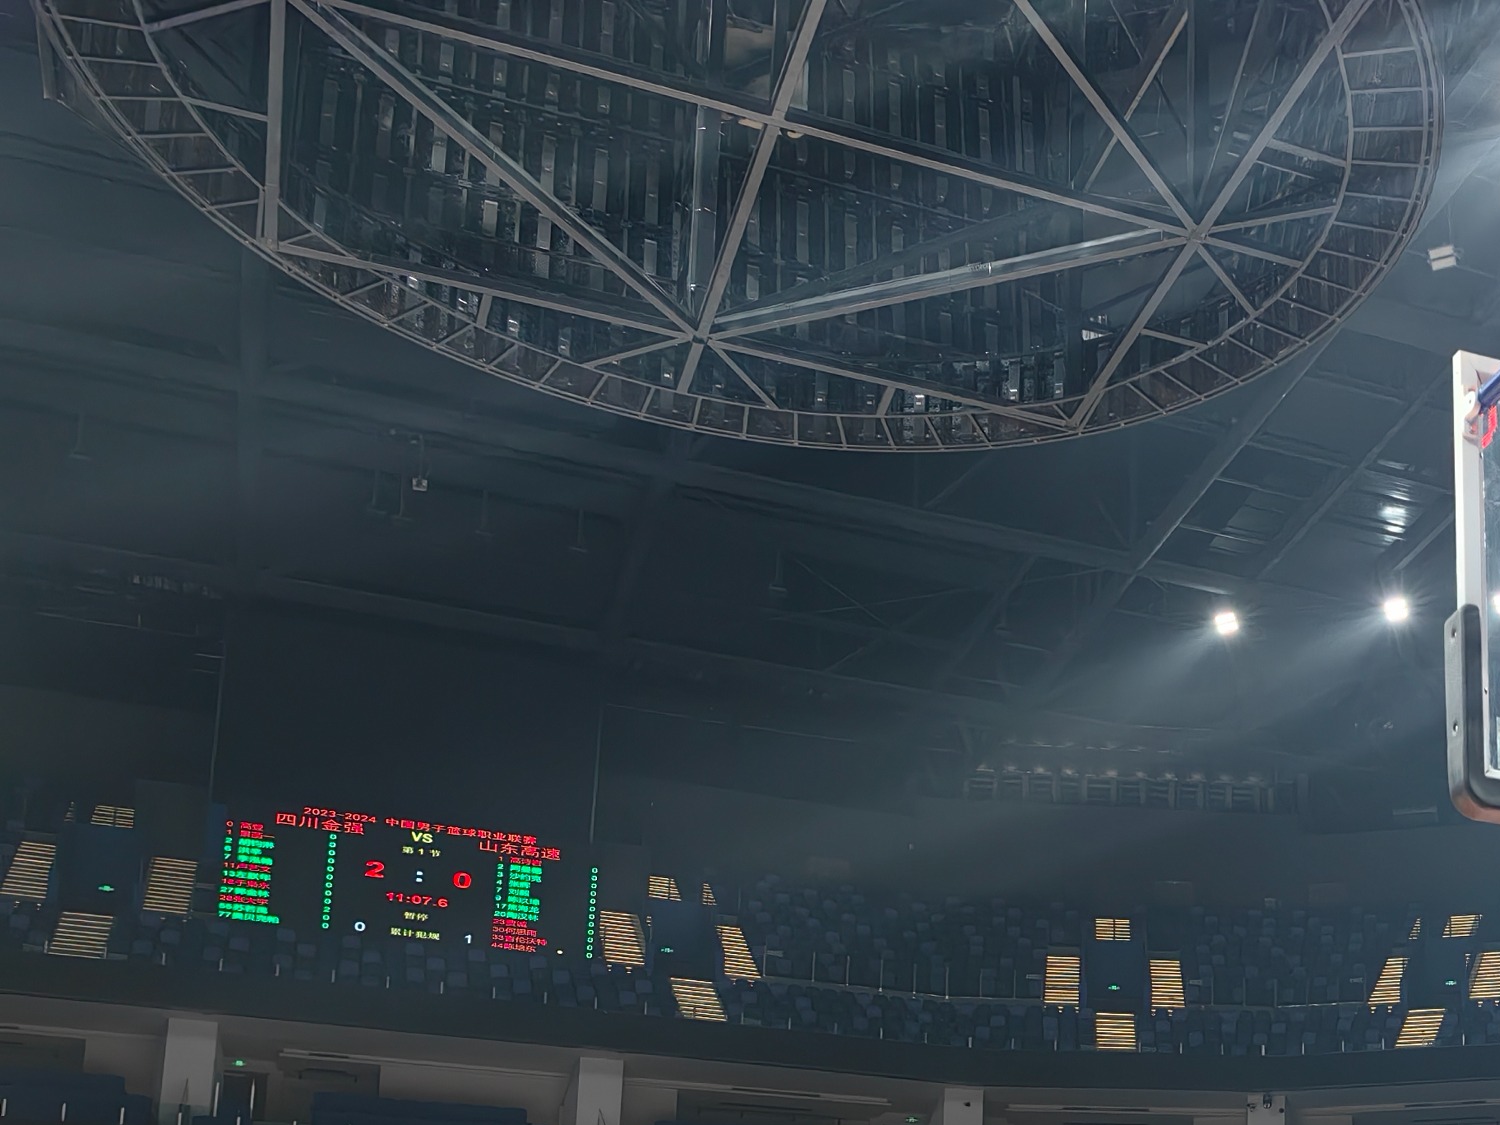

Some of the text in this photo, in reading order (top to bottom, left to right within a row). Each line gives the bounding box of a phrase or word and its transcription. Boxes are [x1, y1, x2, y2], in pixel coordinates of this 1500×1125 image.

[276, 813, 365, 836] 四川金强
[304, 807, 538, 845] 2023-2024 中国男子篮球职业联赛
[411, 831, 434, 843] VS
[479, 840, 561, 861] 山东高速
[364, 860, 385, 879] 2
[452, 871, 472, 889] 0
[386, 892, 449, 908] 11:07.6
[354, 921, 366, 932] 0
